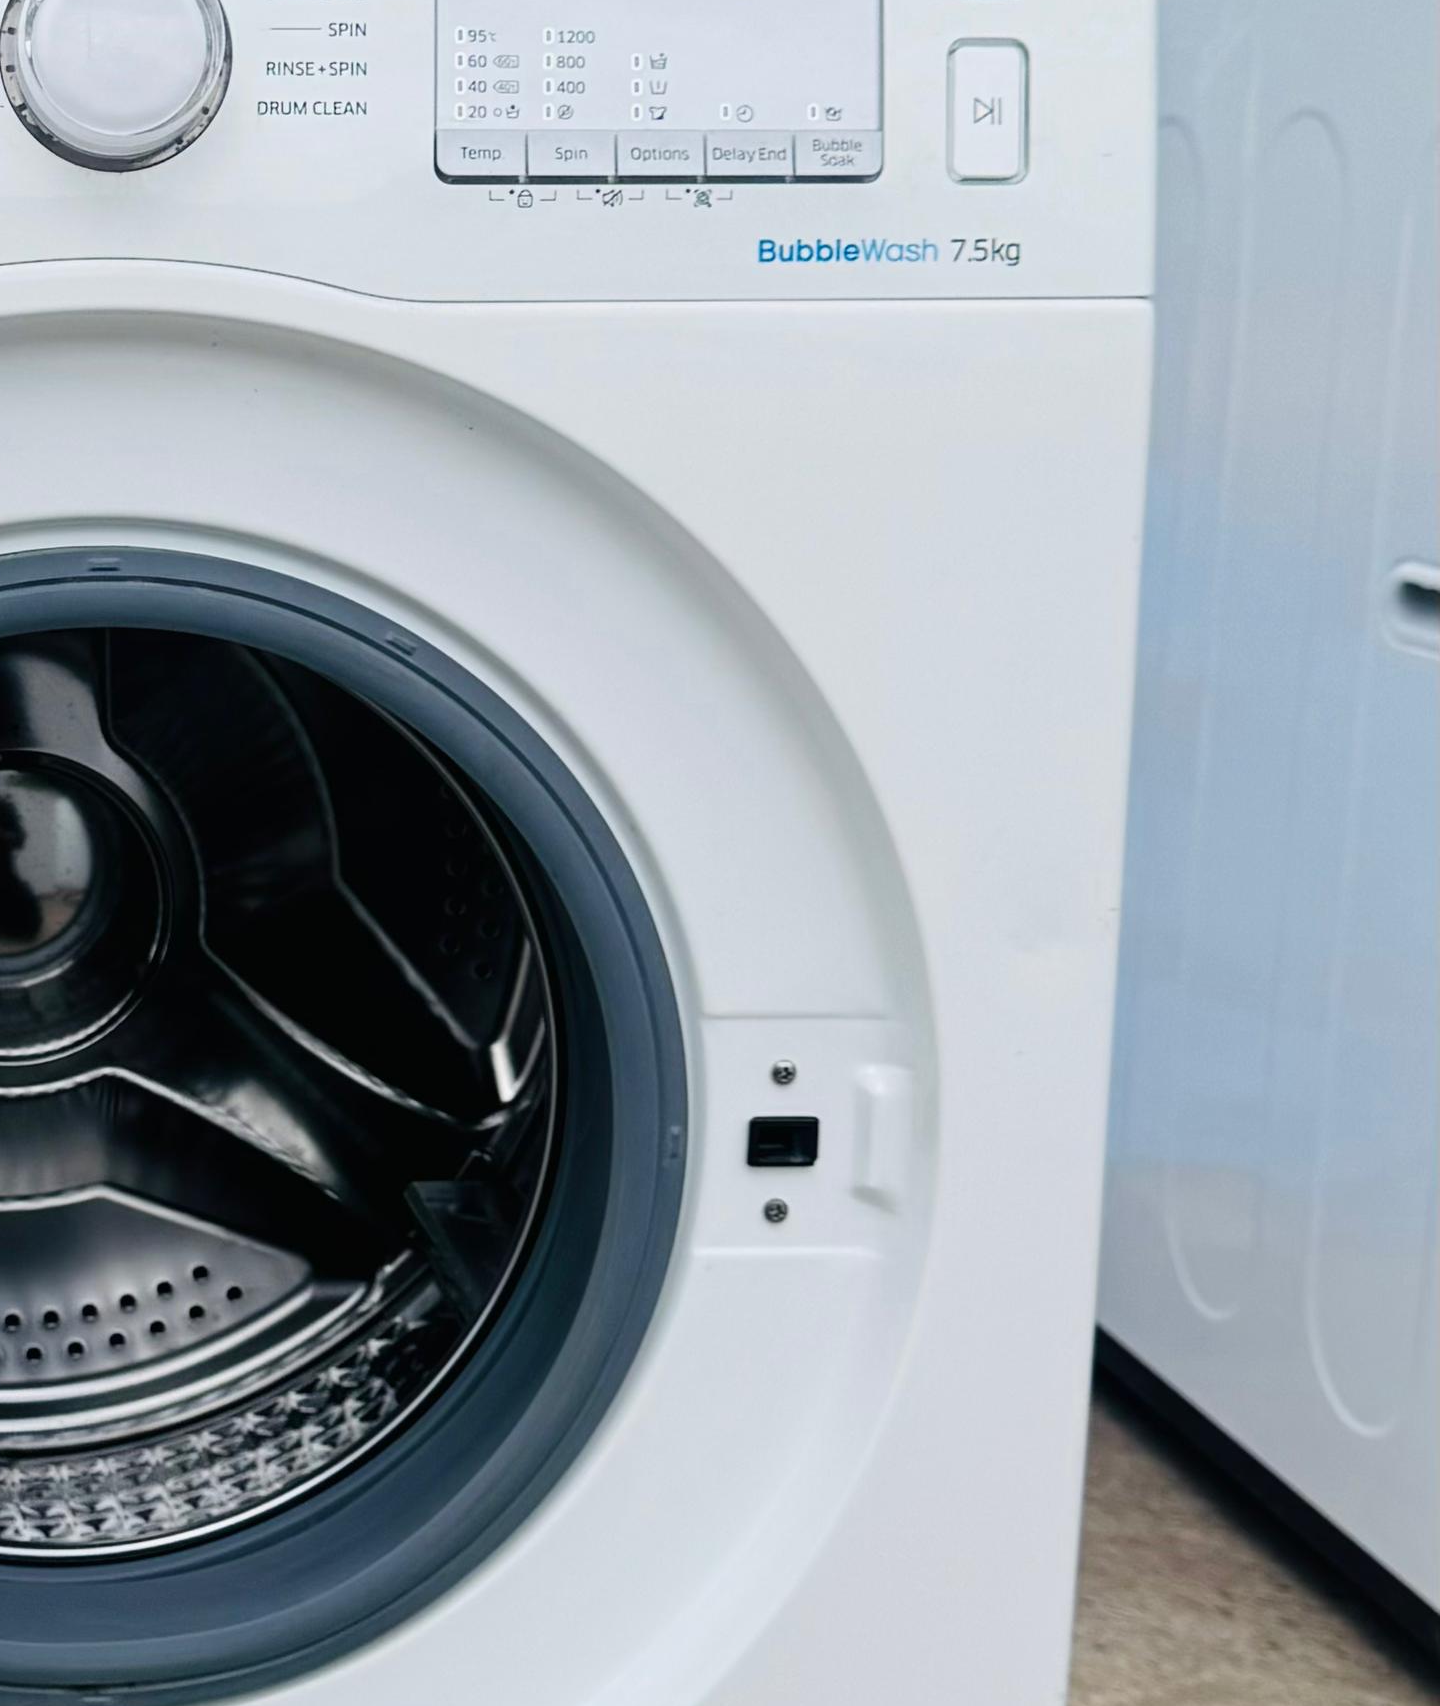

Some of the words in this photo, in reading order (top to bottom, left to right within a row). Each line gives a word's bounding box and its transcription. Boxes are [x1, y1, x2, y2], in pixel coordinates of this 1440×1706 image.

[328, 23, 367, 37] SPIN
[558, 30, 596, 44] 1200
[467, 54, 487, 68] 60
[556, 55, 586, 69] 800
[468, 80, 487, 93] 40
[557, 80, 586, 94] 400
[257, 100, 308, 116] DRUM
[312, 101, 368, 116] CLEAN
[468, 105, 487, 119] 20
[812, 138, 863, 153] Bubble
[554, 146, 588, 161] Spin
[630, 146, 690, 162] Options
[712, 146, 756, 163] Delay
[758, 146, 787, 161] End
[820, 153, 855, 167] Soak
[757, 238, 939, 263] BubbleWash
[950, 238, 1021, 266] 7.5kg
